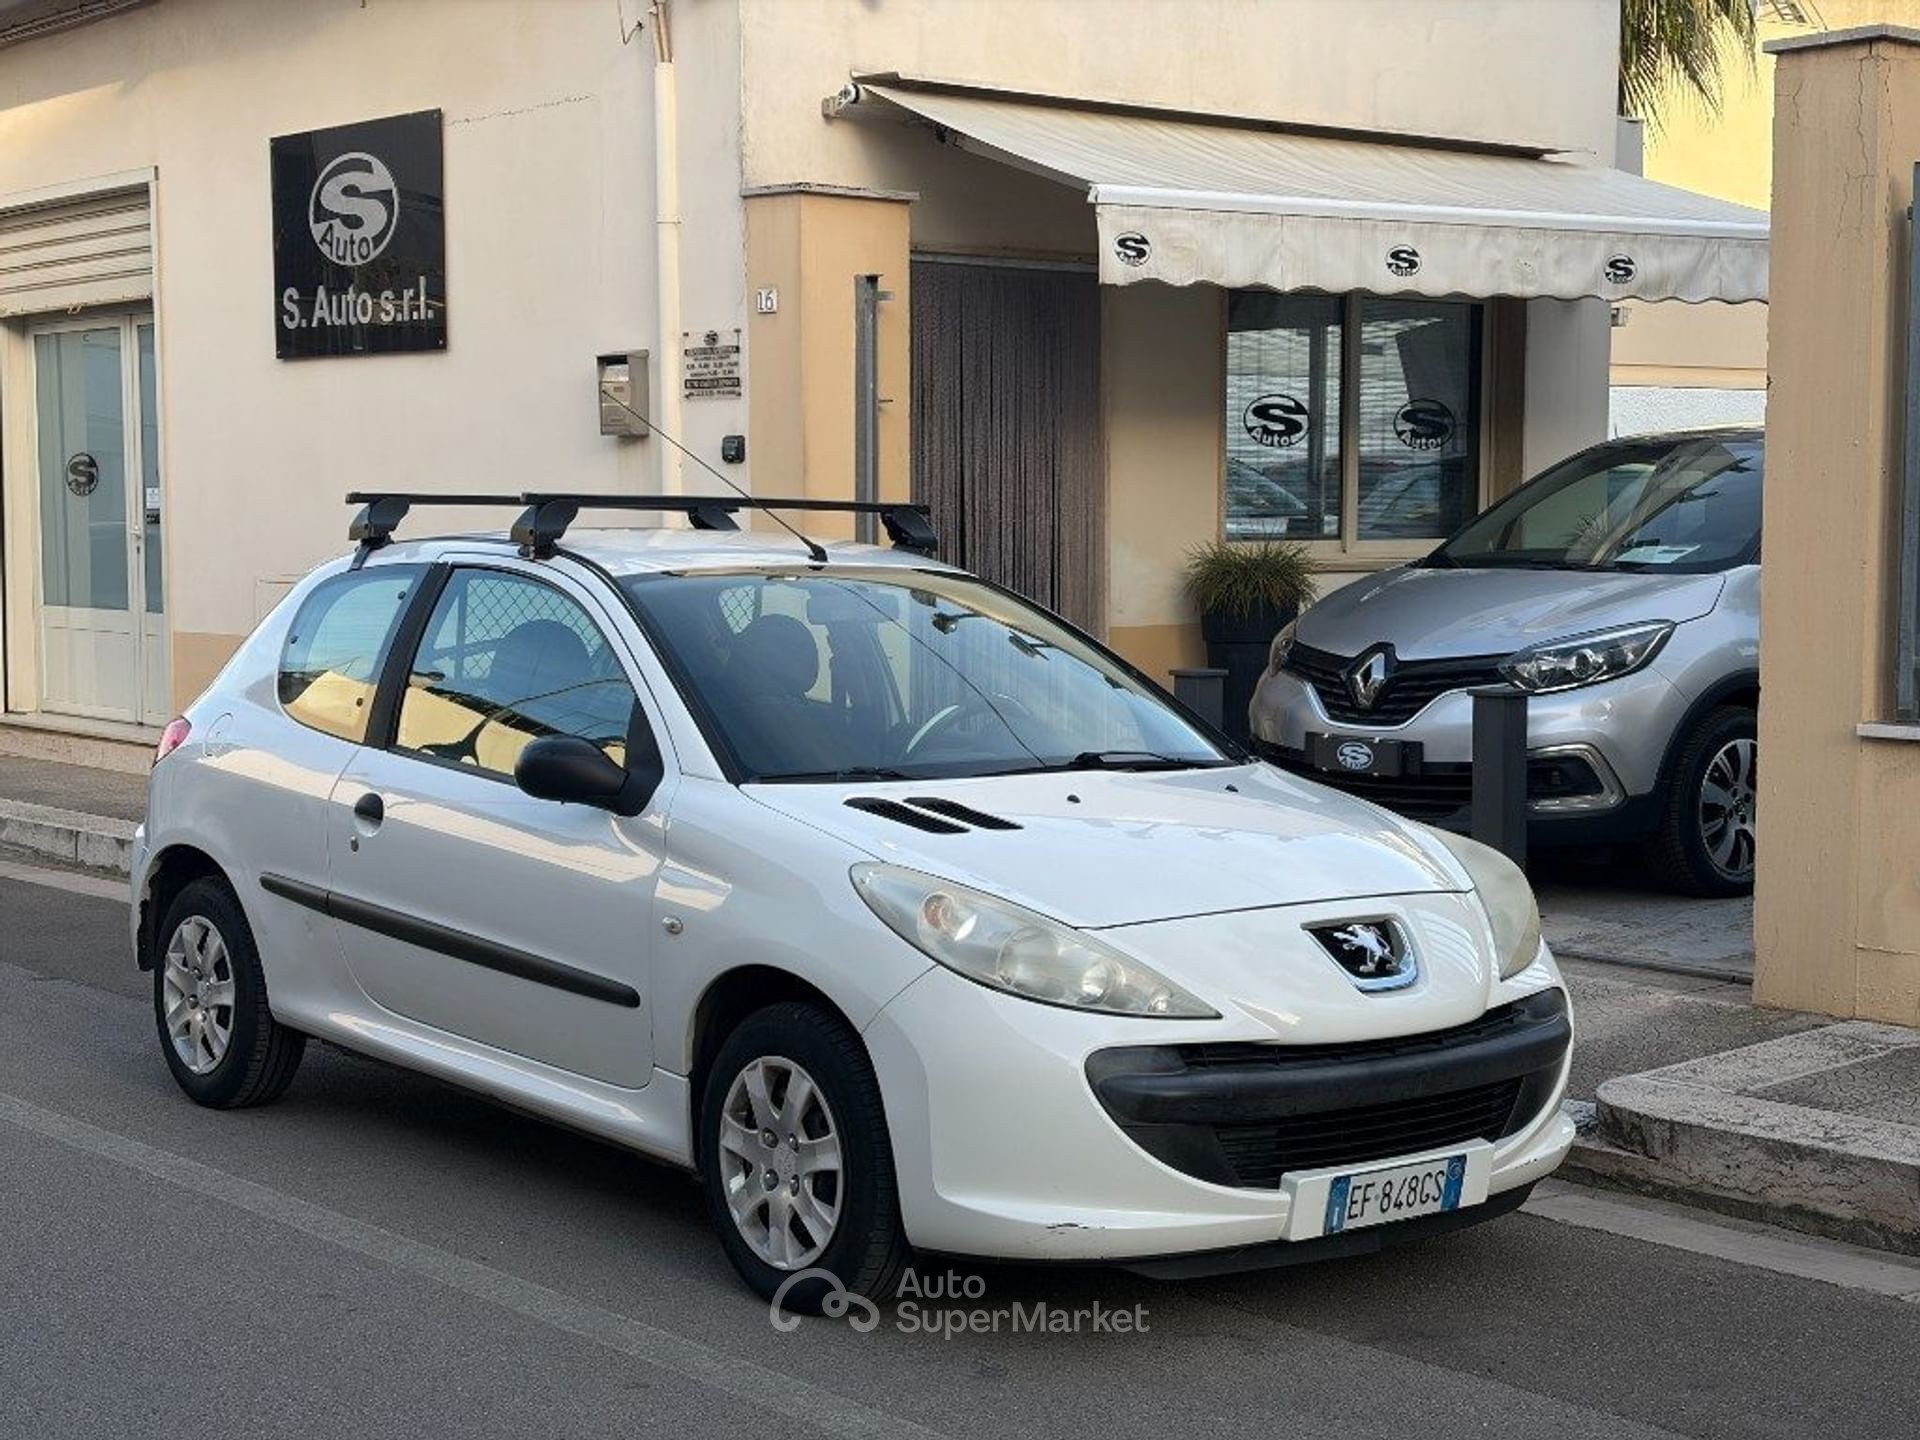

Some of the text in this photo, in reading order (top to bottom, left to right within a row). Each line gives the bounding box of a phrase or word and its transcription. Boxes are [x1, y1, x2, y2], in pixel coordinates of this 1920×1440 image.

[319, 160, 394, 238] S
[319, 224, 372, 262] Auto
[283, 276, 434, 329] S. Auto s.r.l.
[758, 290, 774, 310] 16
[1251, 427, 1290, 446] Auto
[1252, 400, 1308, 437] S
[1347, 1169, 1446, 1220] EF 848GS
